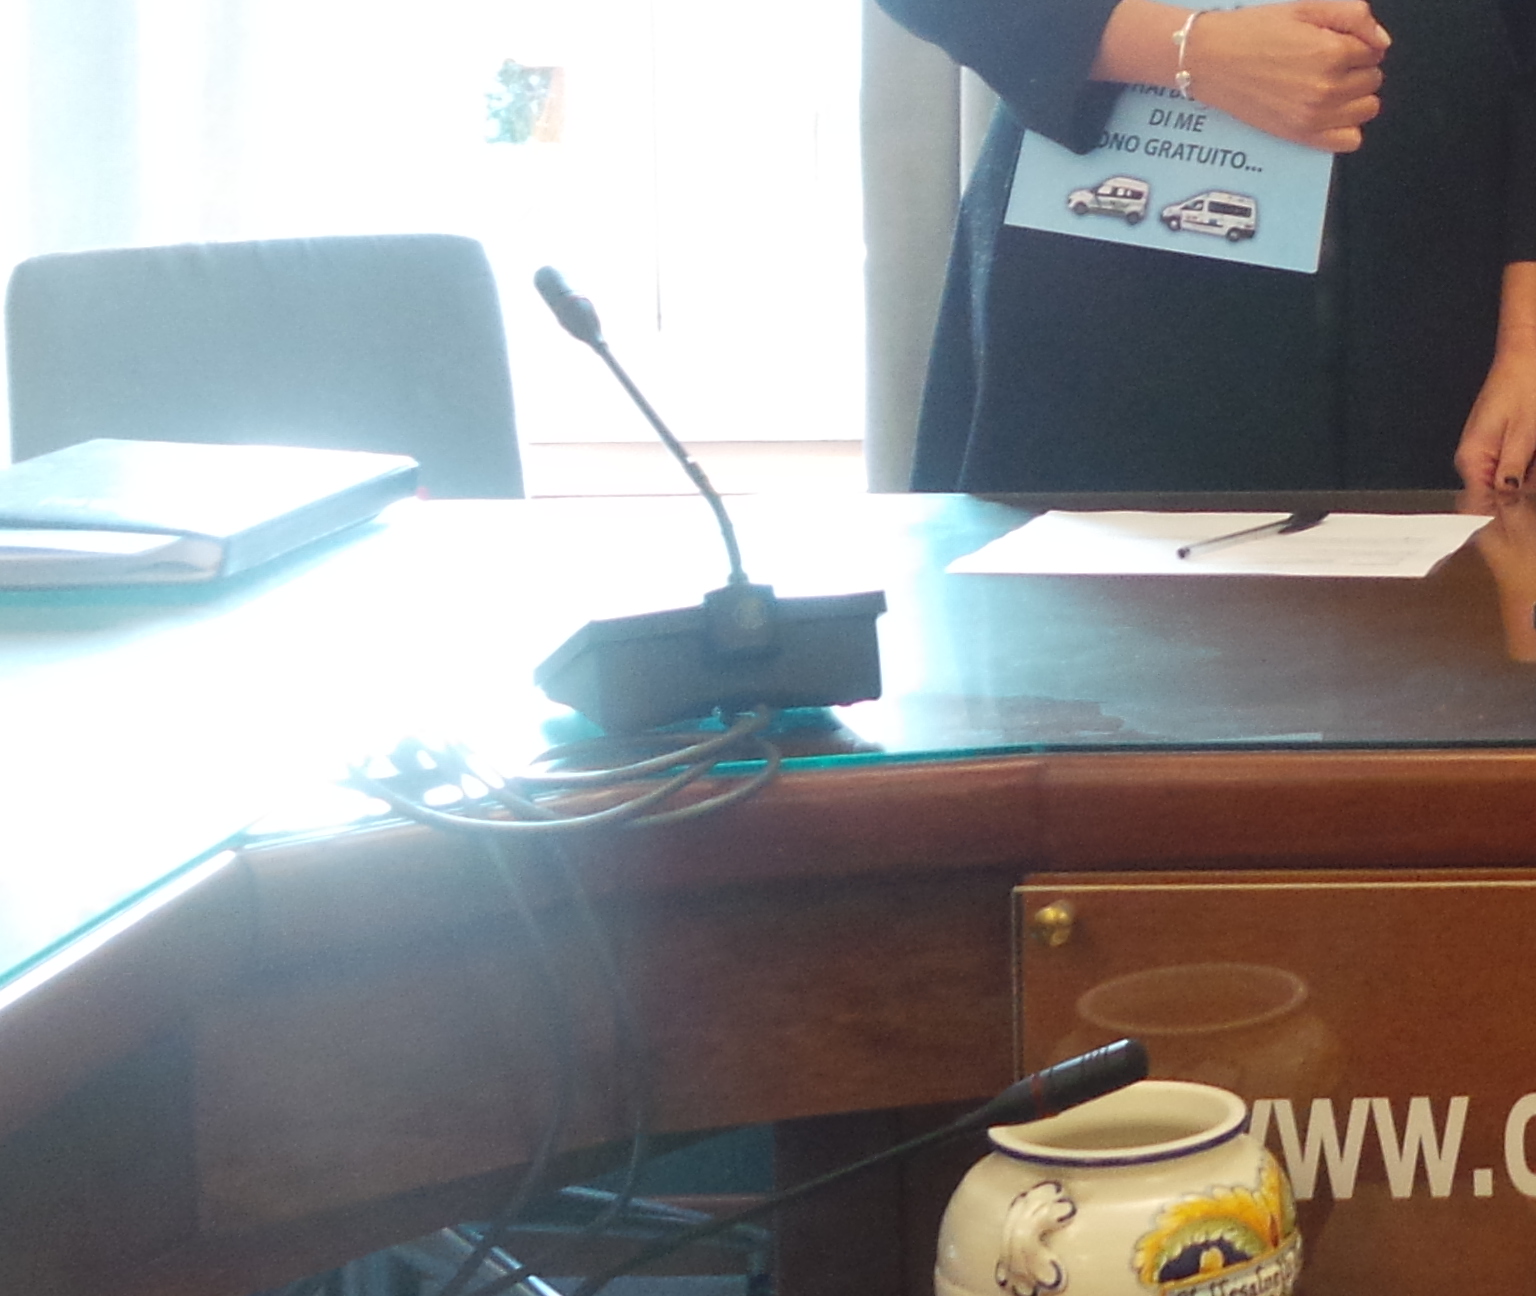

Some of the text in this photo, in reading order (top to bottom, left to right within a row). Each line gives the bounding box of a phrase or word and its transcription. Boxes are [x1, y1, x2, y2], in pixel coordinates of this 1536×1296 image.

[1149, 107, 1207, 133] DI ME
[1098, 130, 1264, 174] ONO GRATUITO...
